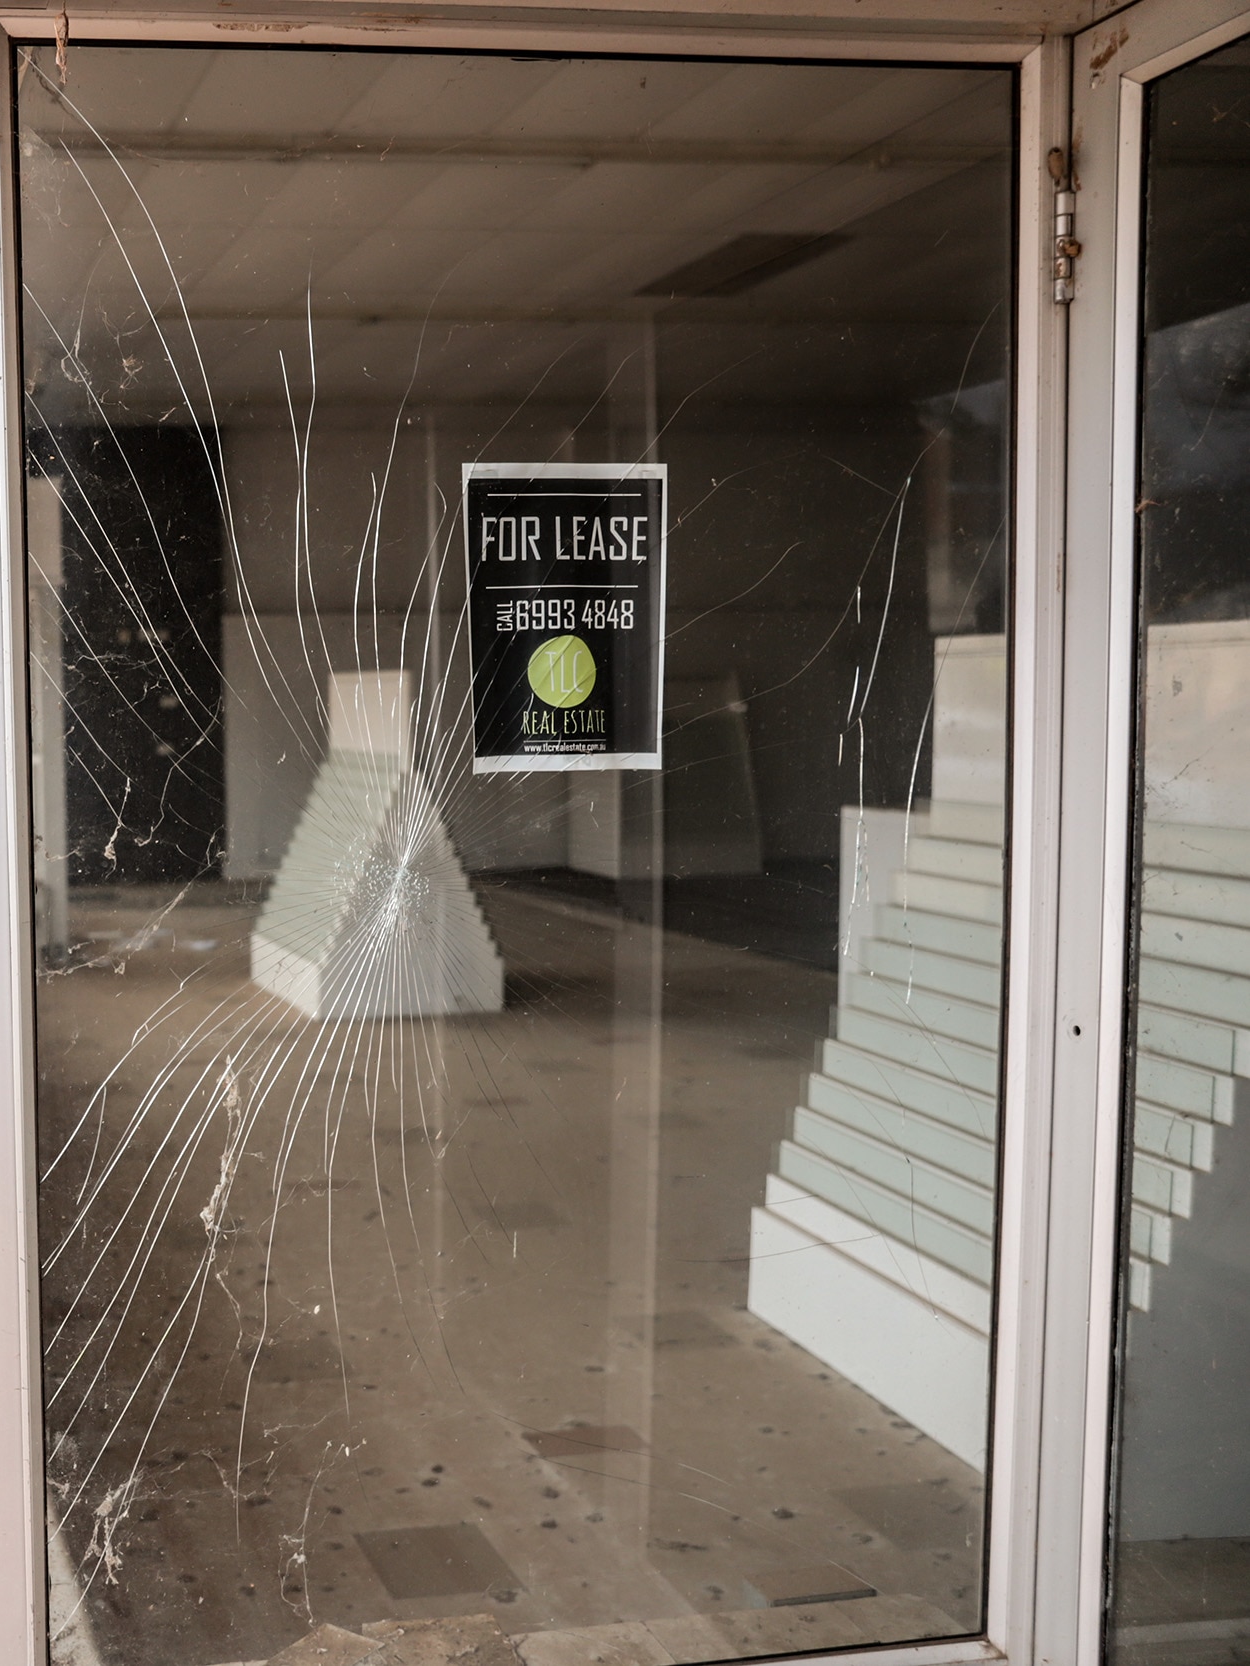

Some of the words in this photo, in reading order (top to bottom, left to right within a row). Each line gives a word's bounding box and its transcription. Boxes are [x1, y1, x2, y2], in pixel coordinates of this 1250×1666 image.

[481, 516, 541, 561] FOR
[554, 515, 648, 561] LEASE
[496, 600, 513, 632] CALL
[516, 599, 575, 631] 6993
[582, 599, 634, 629] 4848
[545, 650, 584, 694] TLC
[523, 710, 558, 735] REAL
[563, 709, 606, 734] ESTATE
[523, 742, 606, 753] www.tlcrealestate.com.au
